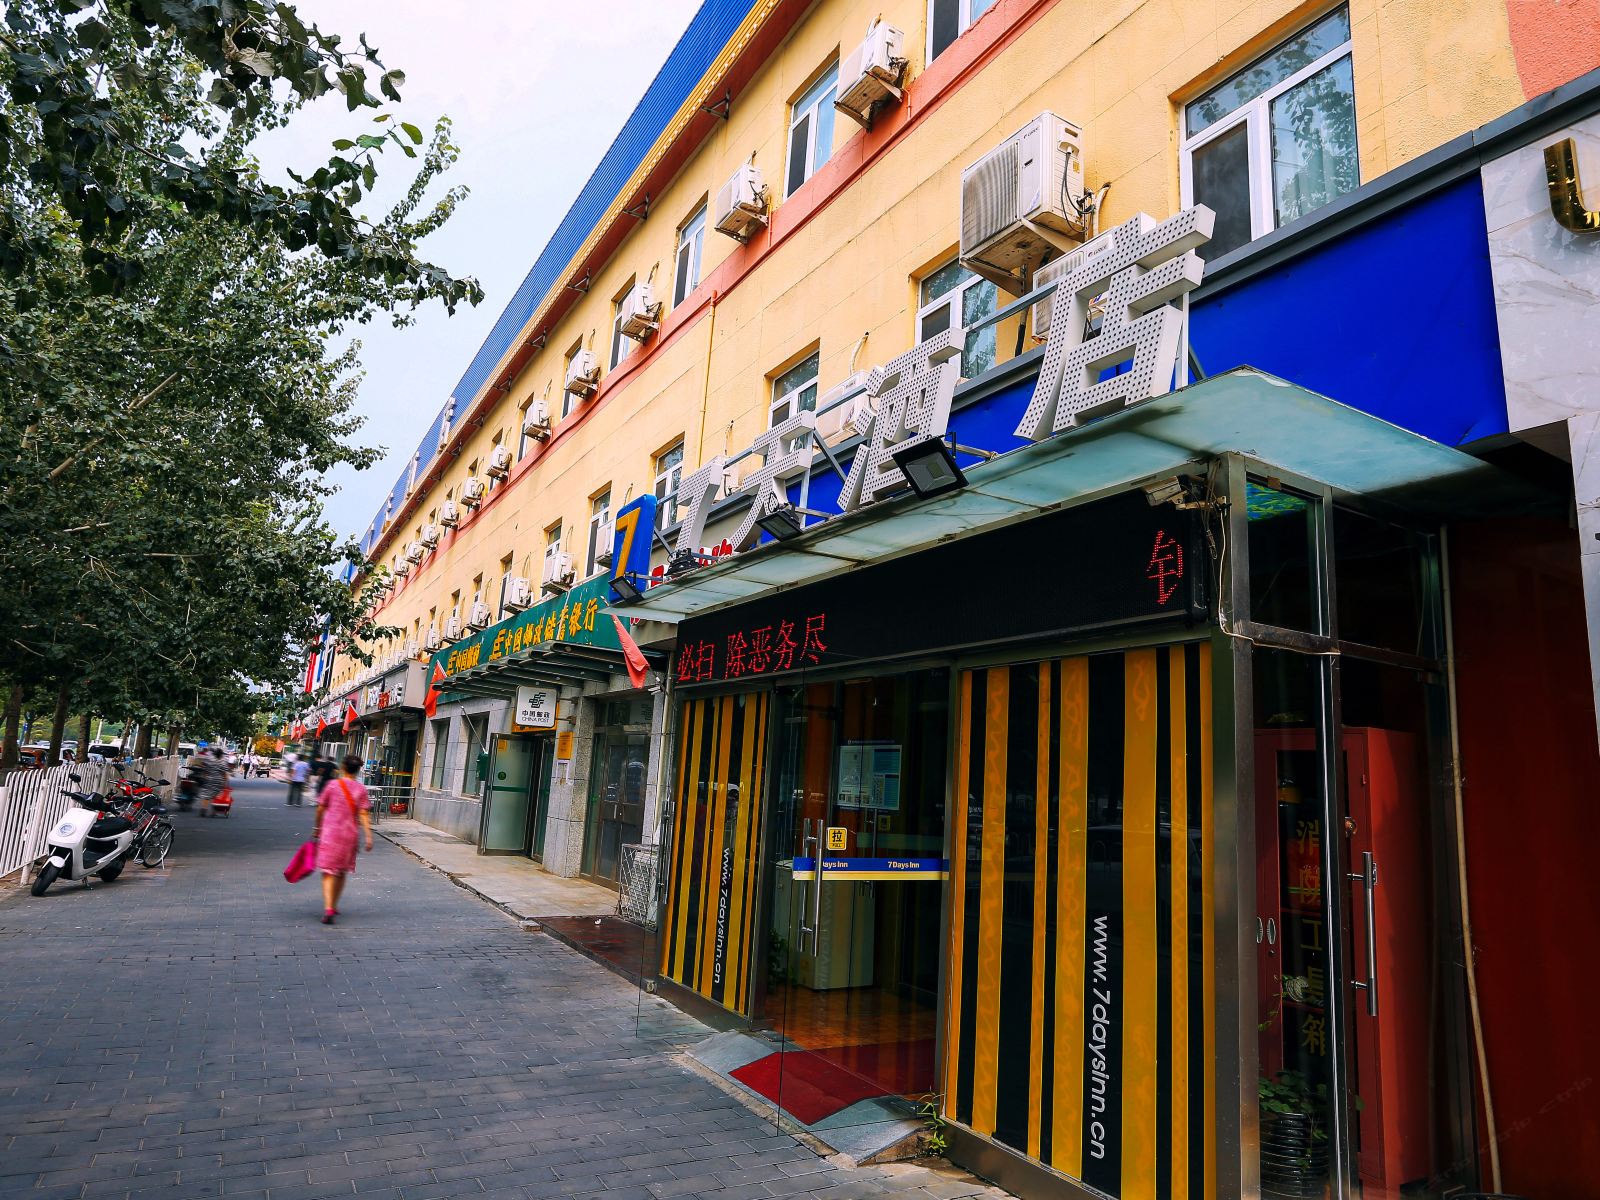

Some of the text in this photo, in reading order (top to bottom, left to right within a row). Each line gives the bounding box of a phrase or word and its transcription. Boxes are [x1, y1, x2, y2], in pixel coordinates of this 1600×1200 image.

[615, 507, 641, 580] 7
[677, 613, 828, 683] 必扫 除恶务尽
[521, 709, 550, 718] 中国邮政
[832, 830, 843, 842] 拉
[713, 847, 731, 984] www.7daysinn.cn
[1088, 914, 1112, 1160] www.7daysinn.cn
